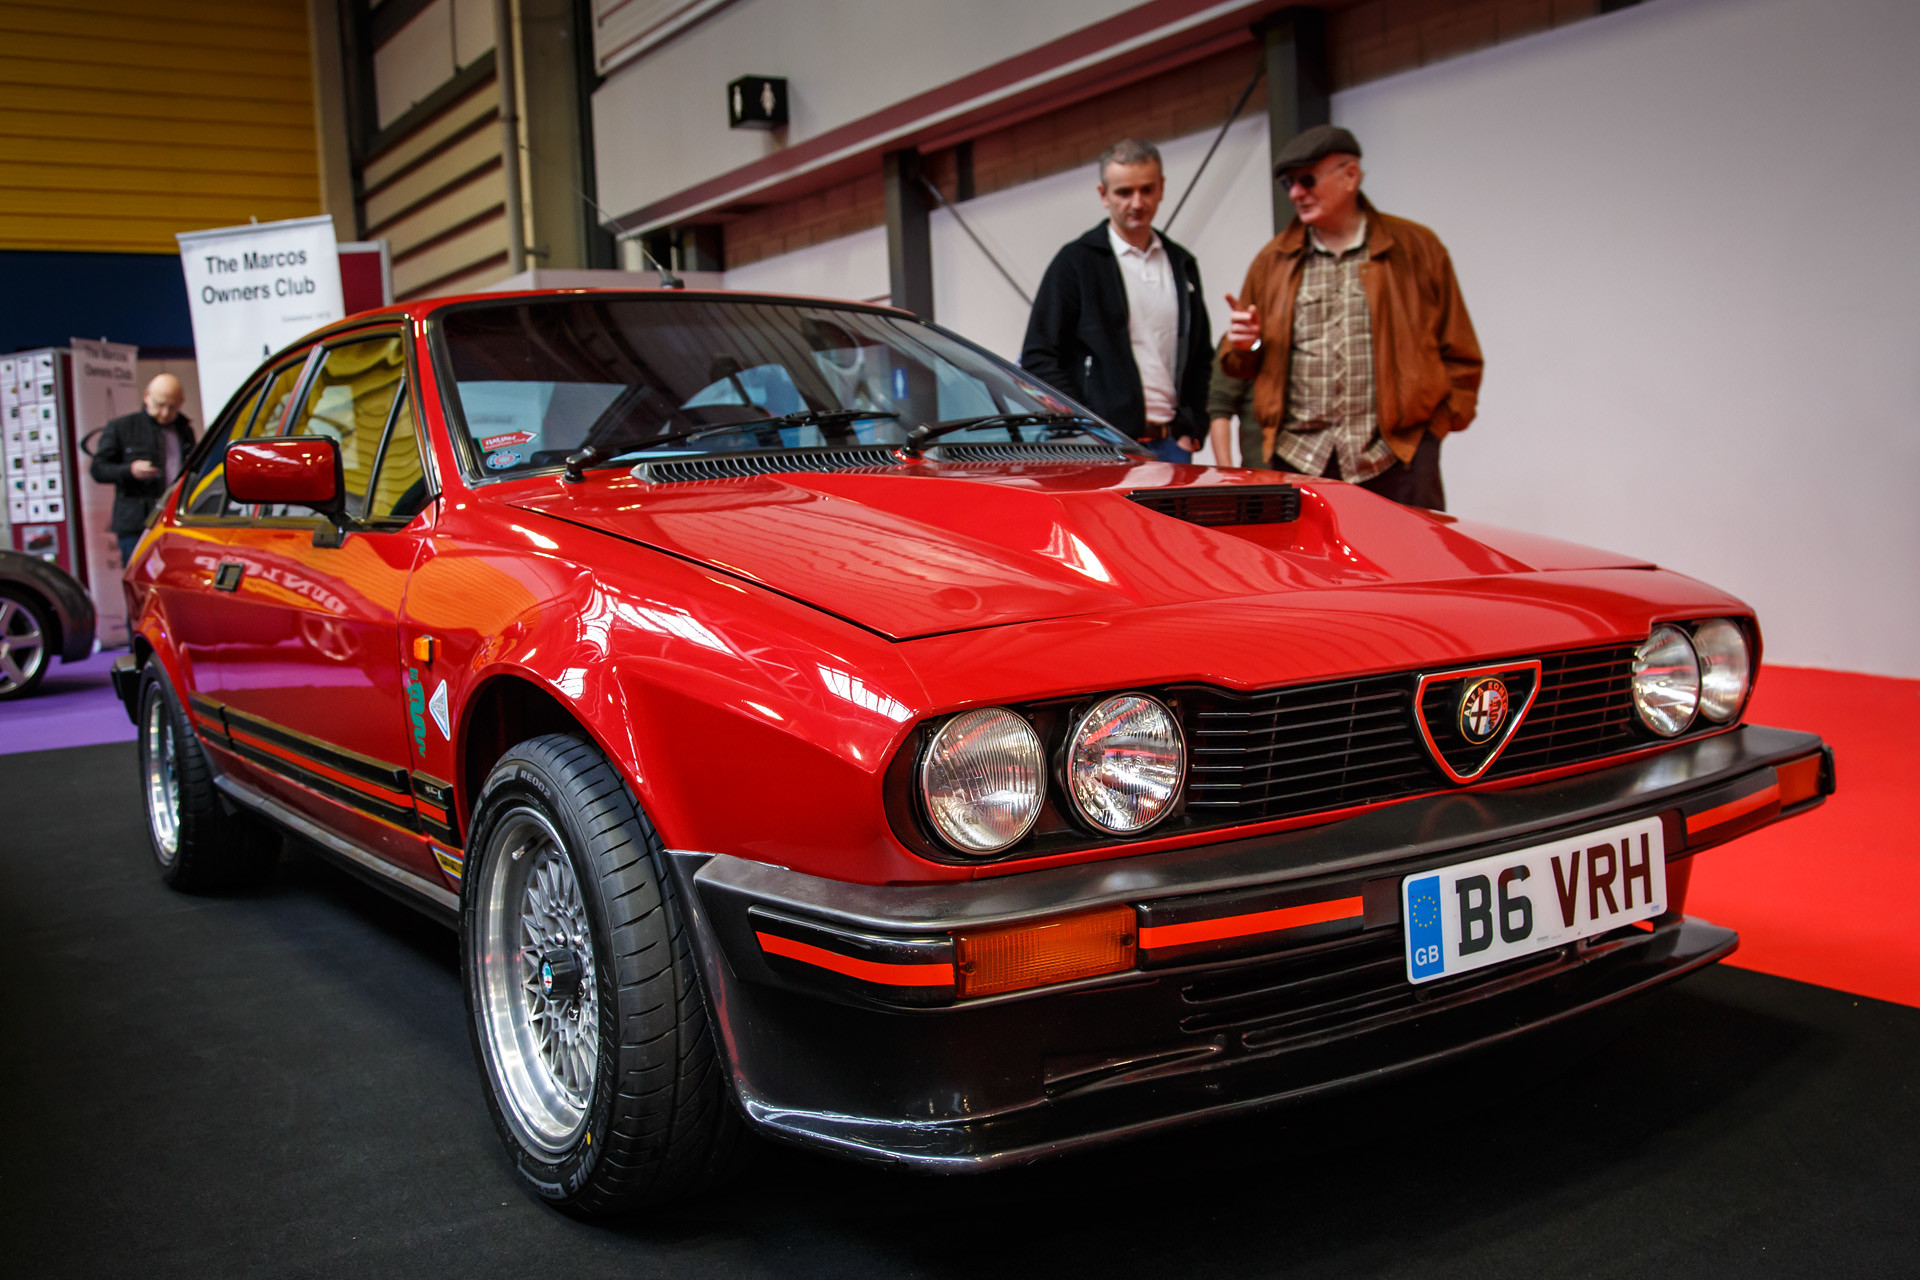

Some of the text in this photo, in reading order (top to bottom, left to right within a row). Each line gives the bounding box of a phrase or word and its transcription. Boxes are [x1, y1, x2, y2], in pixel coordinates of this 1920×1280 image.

[205, 250, 307, 274] The Marcos
[202, 276, 316, 305] Owners Club
[1464, 682, 1507, 717] ALFA ROMEO
[1455, 832, 1653, 957] B6 VRH
[1414, 944, 1440, 967] GB
